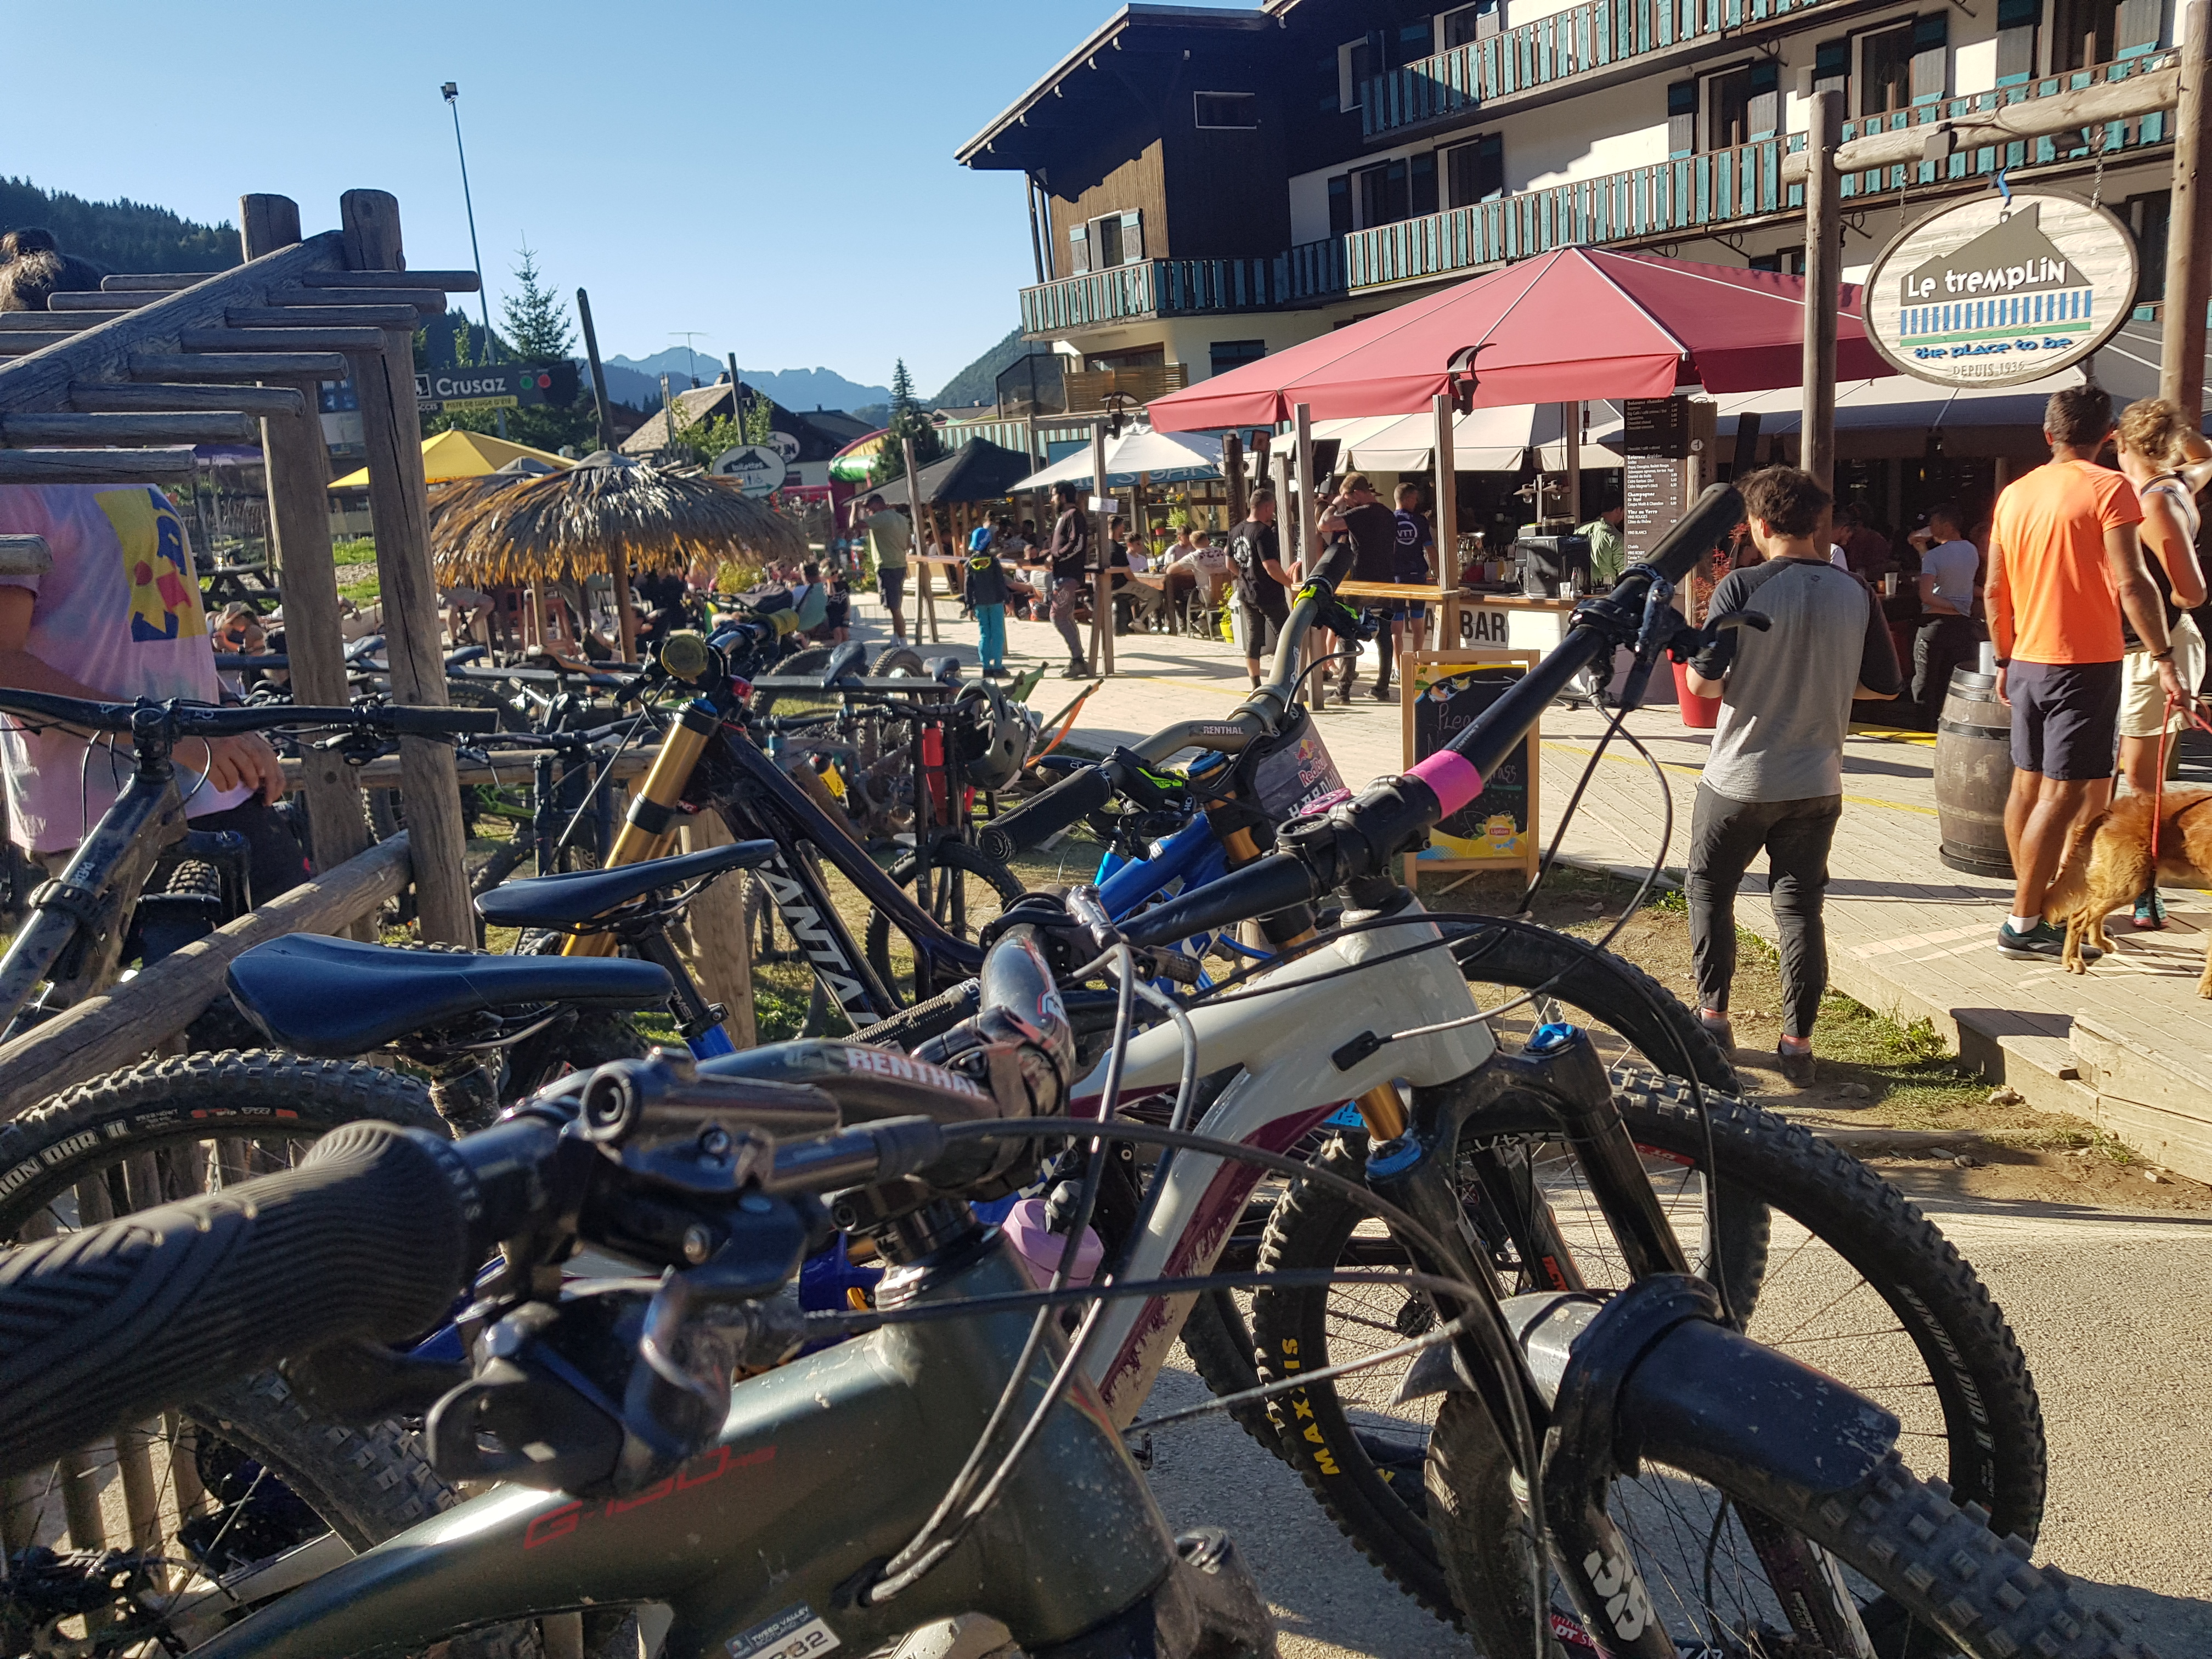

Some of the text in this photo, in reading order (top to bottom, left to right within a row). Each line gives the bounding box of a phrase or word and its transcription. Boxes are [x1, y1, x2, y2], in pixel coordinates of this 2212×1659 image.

[1908, 274, 1937, 298] Le
[2015, 338, 2037, 351] to
[2042, 336, 2072, 349] be
[1953, 361, 2025, 377] DEPUIS 1936
[436, 377, 506, 396] Crusaz
[1397, 529, 1414, 538] VTT
[1460, 610, 1506, 642] BAR
[1203, 726, 1244, 735] RENTHAL
[845, 1047, 988, 1101] RENTHAL
[40, 1129, 100, 1165] DHR
[779, 1605, 809, 1626] VALLEY
[1555, 1624, 1578, 1640] DT
